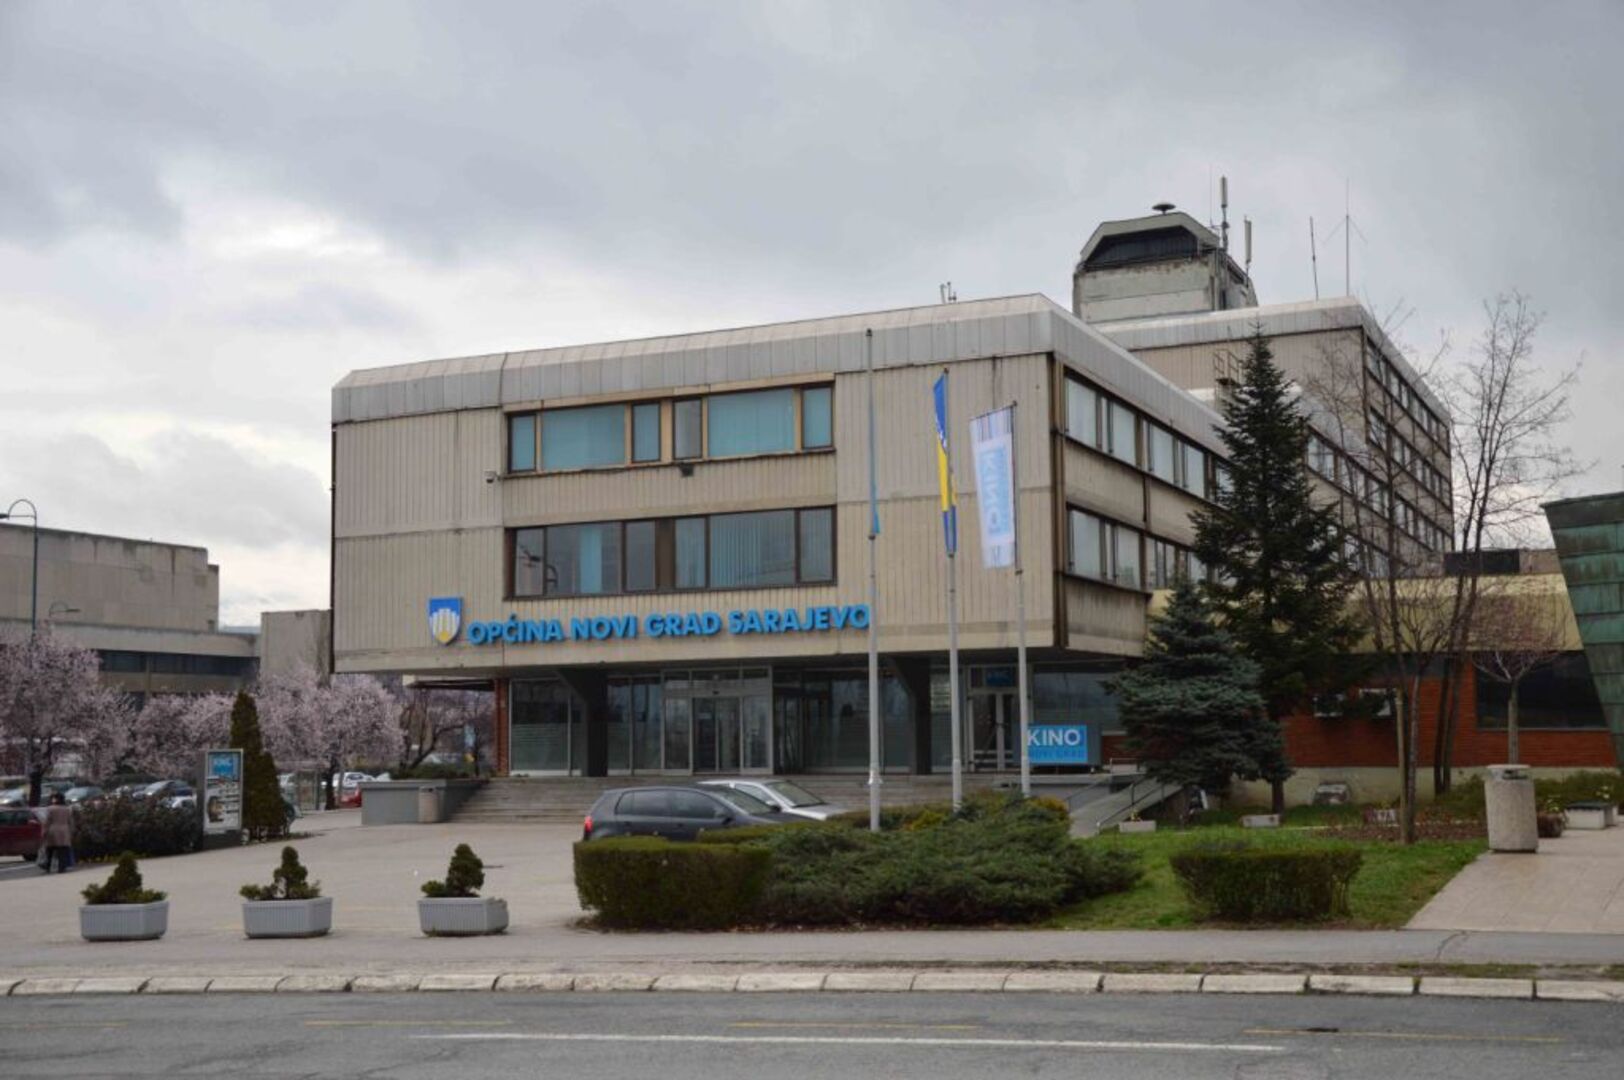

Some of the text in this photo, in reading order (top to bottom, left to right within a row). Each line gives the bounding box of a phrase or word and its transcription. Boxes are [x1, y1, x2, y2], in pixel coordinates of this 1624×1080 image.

[467, 603, 870, 645] OPĆINA NOVI GRAD SARAJEVO
[1027, 729, 1081, 746] KINO
